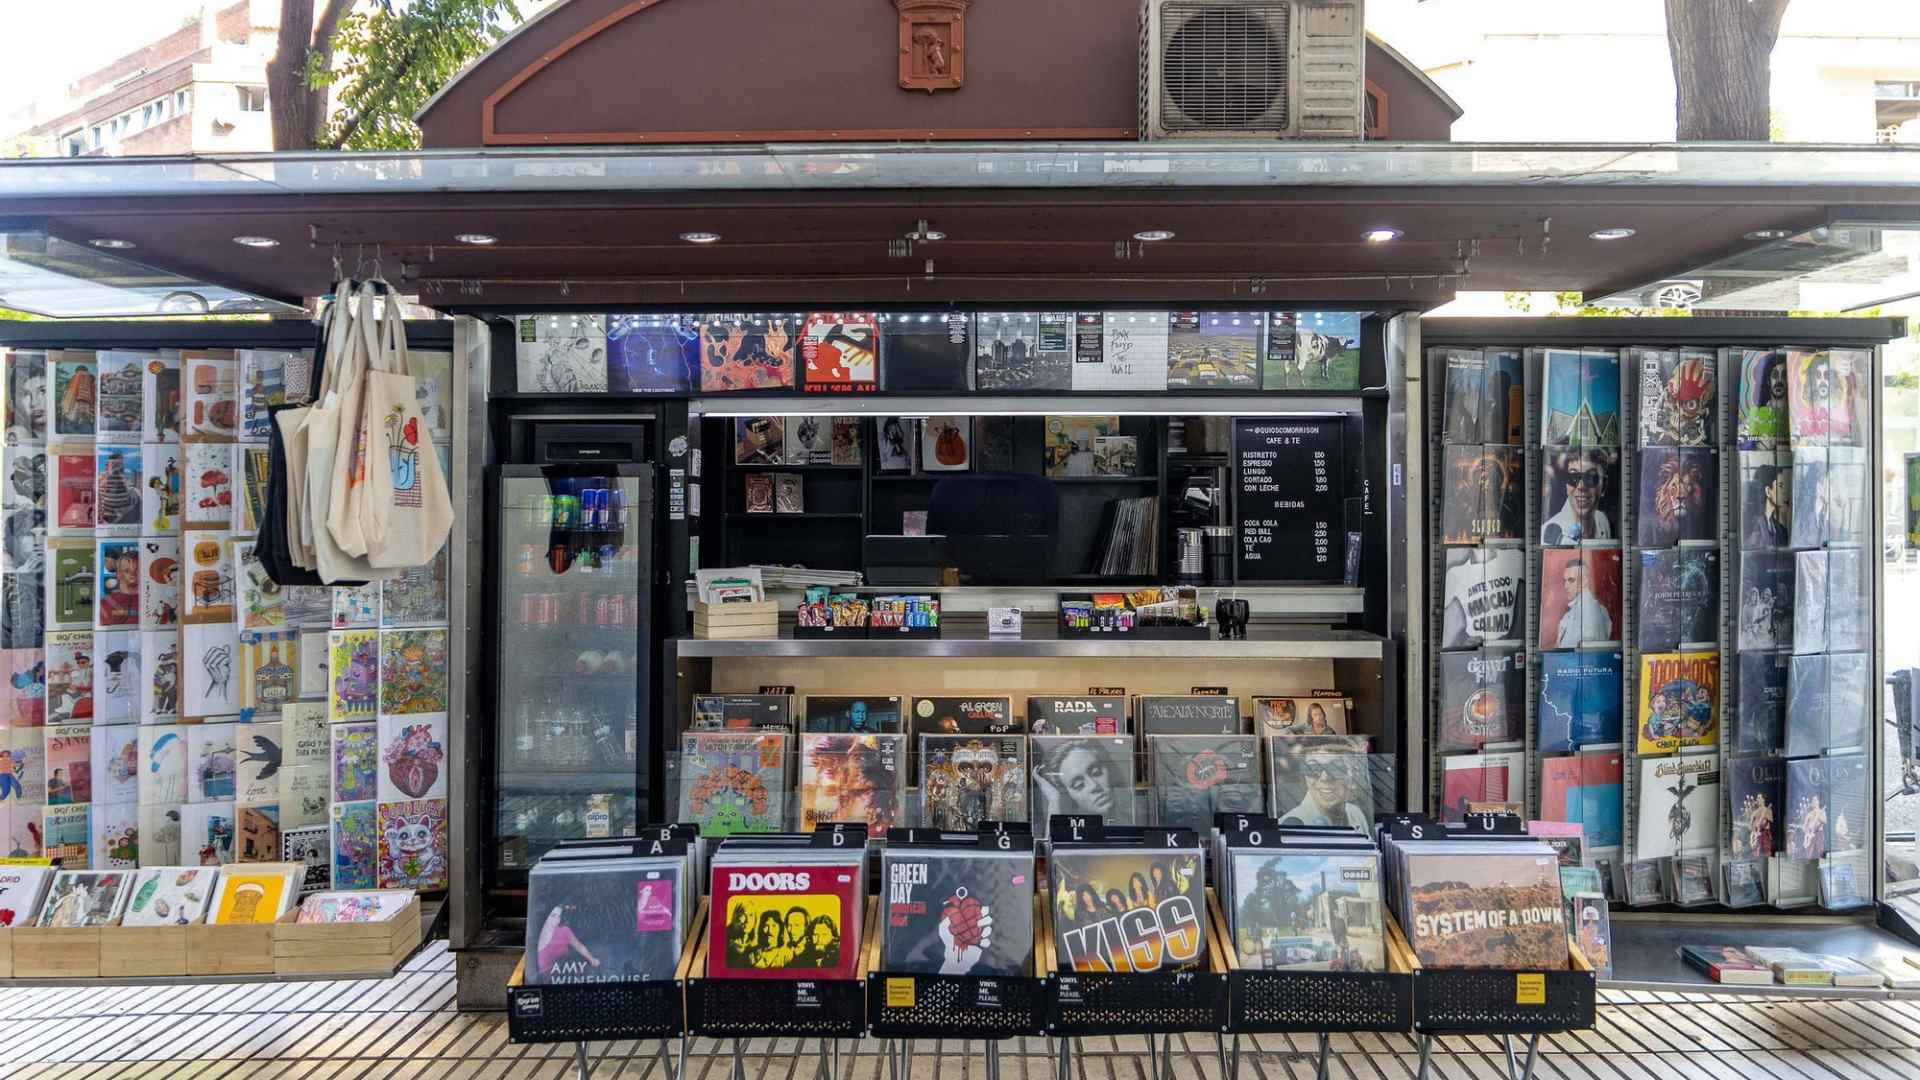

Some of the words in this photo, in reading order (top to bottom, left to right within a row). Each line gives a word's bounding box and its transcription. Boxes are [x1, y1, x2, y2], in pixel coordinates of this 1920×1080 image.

[1467, 581, 1489, 598] ANTE
[1467, 590, 1515, 618] MUCHA
[1054, 701, 1098, 713] RADA
[1239, 820, 1249, 831] P
[1483, 818, 1495, 831] U
[660, 829, 672, 841] B
[1073, 828, 1082, 840] L
[1249, 831, 1262, 846] O
[1411, 826, 1424, 839] S
[833, 833, 845, 846] D
[998, 835, 1011, 849] G
[1166, 834, 1178, 847] K
[651, 840, 663, 854] A
[891, 863, 928, 884] GREEN
[1343, 871, 1370, 880] oasis
[728, 872, 811, 892] DOORS
[891, 884, 912, 904] DAY
[1415, 909, 1487, 938] SYSTEM
[1488, 911, 1506, 927] OF
[1509, 910, 1521, 925] A
[1522, 906, 1562, 925] DOWN
[1063, 896, 1201, 972] KISS
[551, 961, 588, 974] AMY
[551, 974, 651, 985] WINEHOUSE
[979, 980, 997, 988] VINYL
